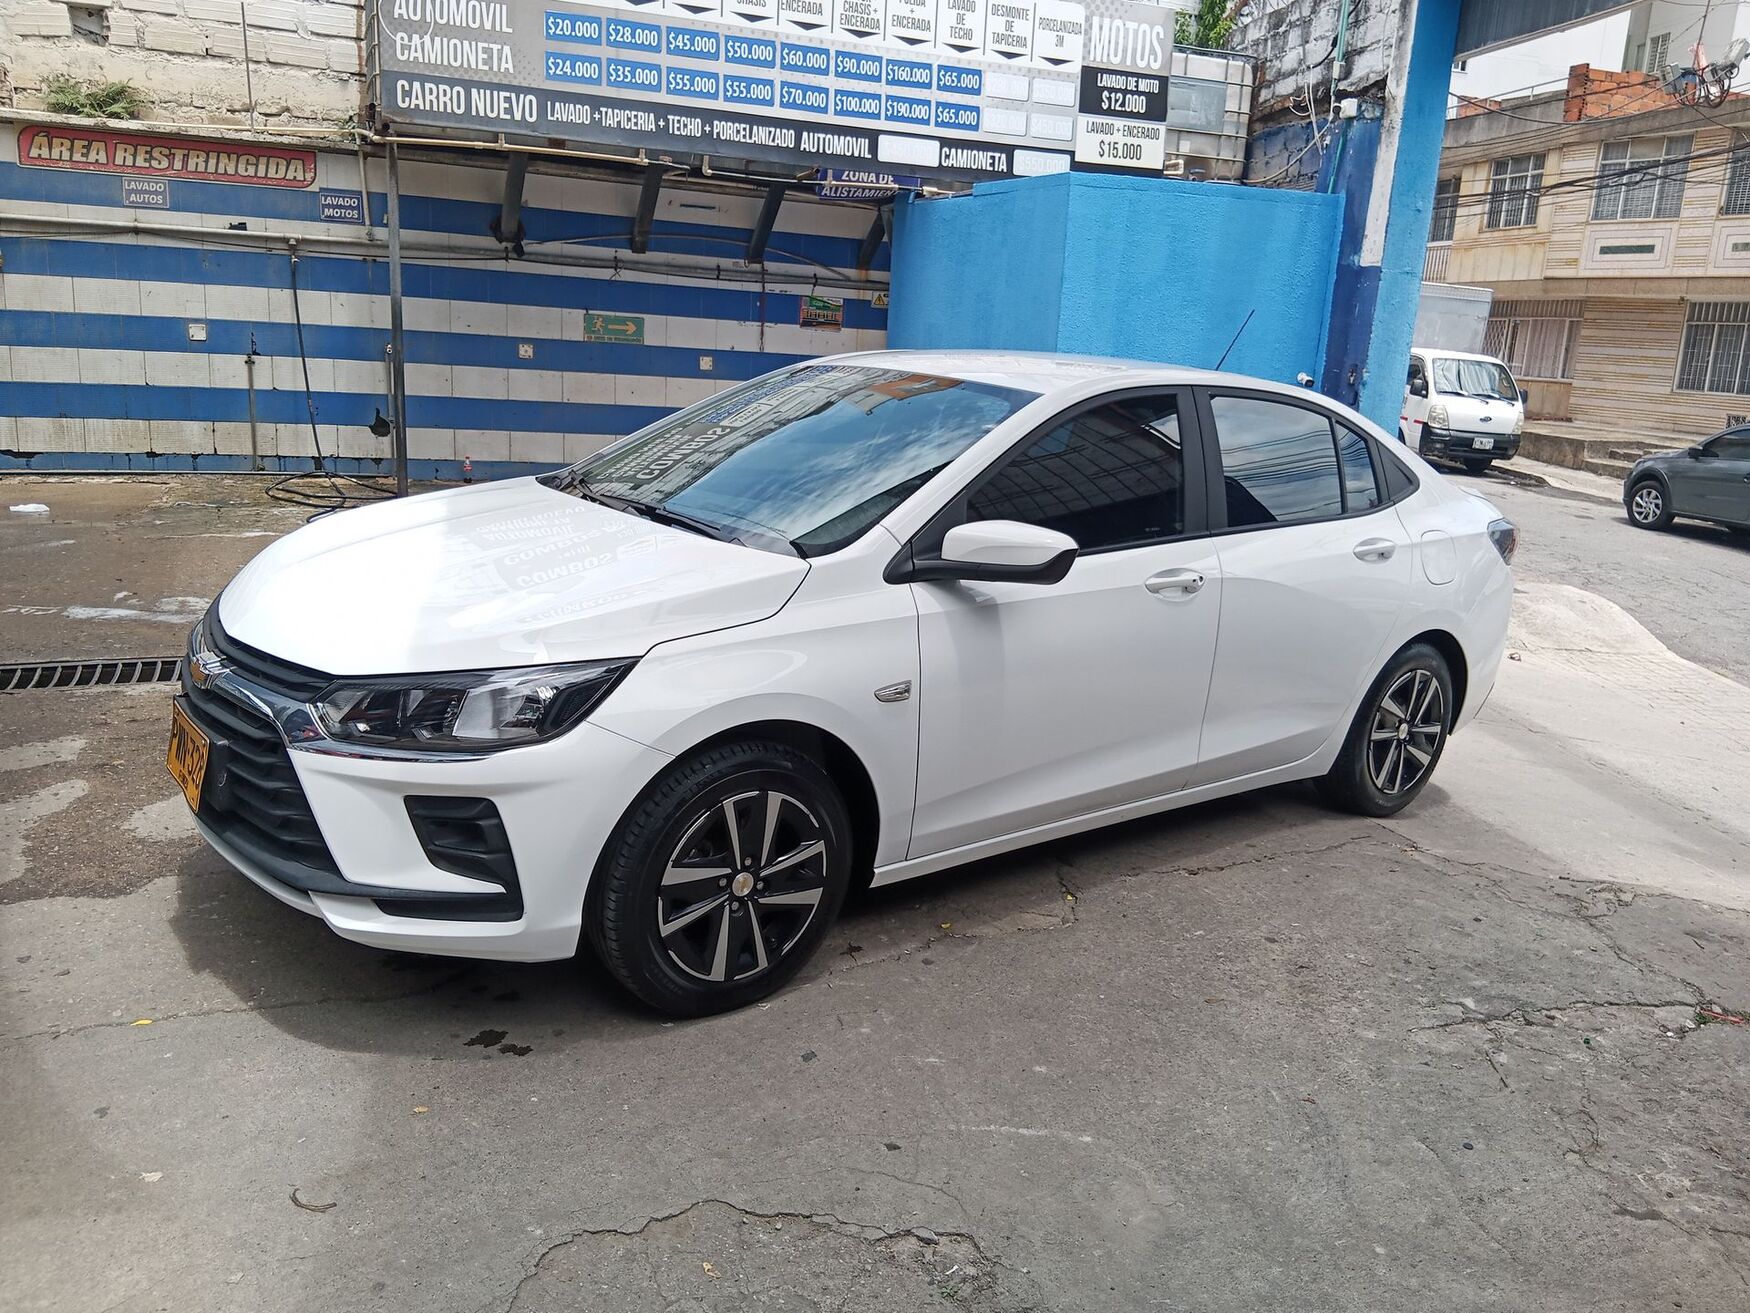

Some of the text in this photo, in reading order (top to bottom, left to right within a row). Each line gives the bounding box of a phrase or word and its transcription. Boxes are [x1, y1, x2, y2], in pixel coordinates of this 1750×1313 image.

[781, 0, 823, 16] ENCERADA
[843, 1, 871, 15] CHASIS
[948, 0, 976, 13] LAVADO
[991, 3, 1029, 21] DESMONTE
[840, 13, 881, 31] ENCERADA
[891, 14, 931, 32] ENCERADA
[957, 13, 966, 25] DE
[1005, 20, 1014, 32] DE
[1038, 17, 1082, 36] PORCELANIZADA
[950, 26, 973, 41] TECHO
[991, 32, 1028, 49] TAPICERIA
[1055, 34, 1065, 48] 3M
[1089, 15, 1165, 70] MOTOS
[395, 31, 514, 74] CAMIONETA
[548, 16, 599, 39] $20.000
[608, 23, 658, 47] $28.000
[669, 32, 717, 54] $45.000
[727, 40, 773, 61] $50.000
[782, 48, 827, 69] $60.000
[837, 55, 880, 76] $90.000
[887, 64, 930, 84] $160.000
[939, 71, 980, 89] $65.000
[548, 56, 599, 79] $24.000
[609, 63, 658, 86] $35.000
[668, 72, 716, 94] $55.000
[726, 80, 772, 101] $55.000
[782, 86, 826, 108] $70.000
[836, 94, 880, 114] $100.000
[886, 99, 929, 120] $190.000
[937, 106, 977, 126] $65.000
[1097, 73, 1159, 94] LAVADO DE MOTO
[1101, 90, 1146, 113] $12.000
[396, 79, 465, 115] CARRO
[471, 88, 538, 123] NUEVO
[547, 101, 591, 125] LAVADO
[658, 120, 666, 129] +
[668, 115, 702, 137] TECHO
[704, 124, 711, 134] +
[713, 120, 795, 148] PORCELANIZADO
[800, 131, 872, 159] AUTOMOVIL
[941, 147, 1007, 173] CAMIONETA
[1086, 120, 1115, 136] LAVADO
[1122, 124, 1160, 141] ENCERADO
[28, 132, 306, 182] ÁREA RESTRINGIDA
[1099, 139, 1142, 161] $15.000
[125, 180, 165, 192] LAVADO
[841, 170, 895, 185] ZONA DE
[130, 193, 163, 204] AUTOS
[321, 196, 358, 207] LAVADO
[324, 208, 359, 219] MOTOS
